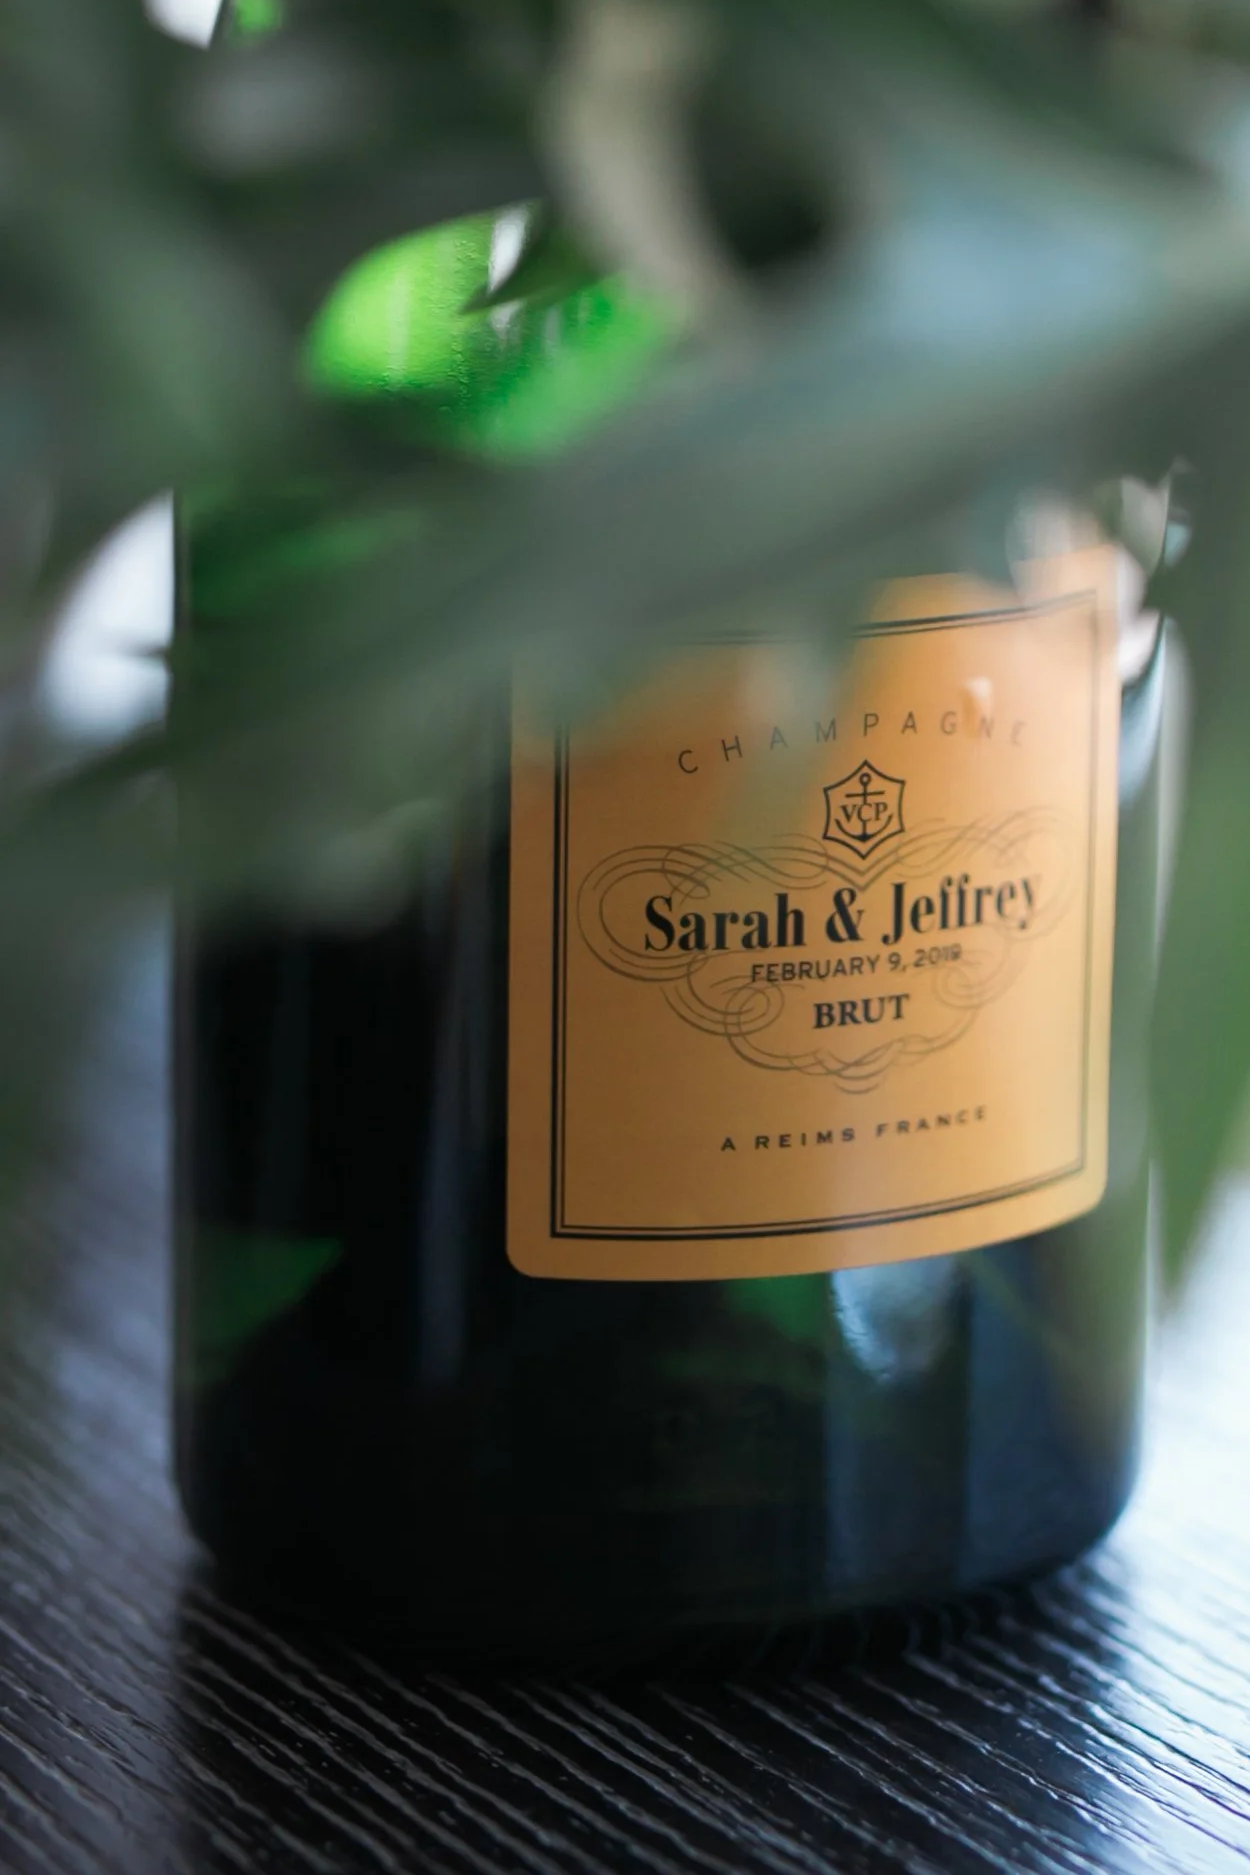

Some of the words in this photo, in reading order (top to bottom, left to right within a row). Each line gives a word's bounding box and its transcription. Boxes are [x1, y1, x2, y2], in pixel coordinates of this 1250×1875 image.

[677, 708, 1027, 775] CHAMPAGNE
[840, 800, 888, 823] VCP
[643, 892, 807, 953] Sarah
[824, 887, 865, 944] &
[881, 872, 1041, 945] Jeffrey
[751, 954, 881, 984] FEBRUARY
[887, 951, 907, 974] 9,
[812, 992, 910, 1030] BRUT
[720, 1136, 737, 1152] A
[754, 1127, 856, 1150] REIMS
[875, 1104, 987, 1138] FRANCE
